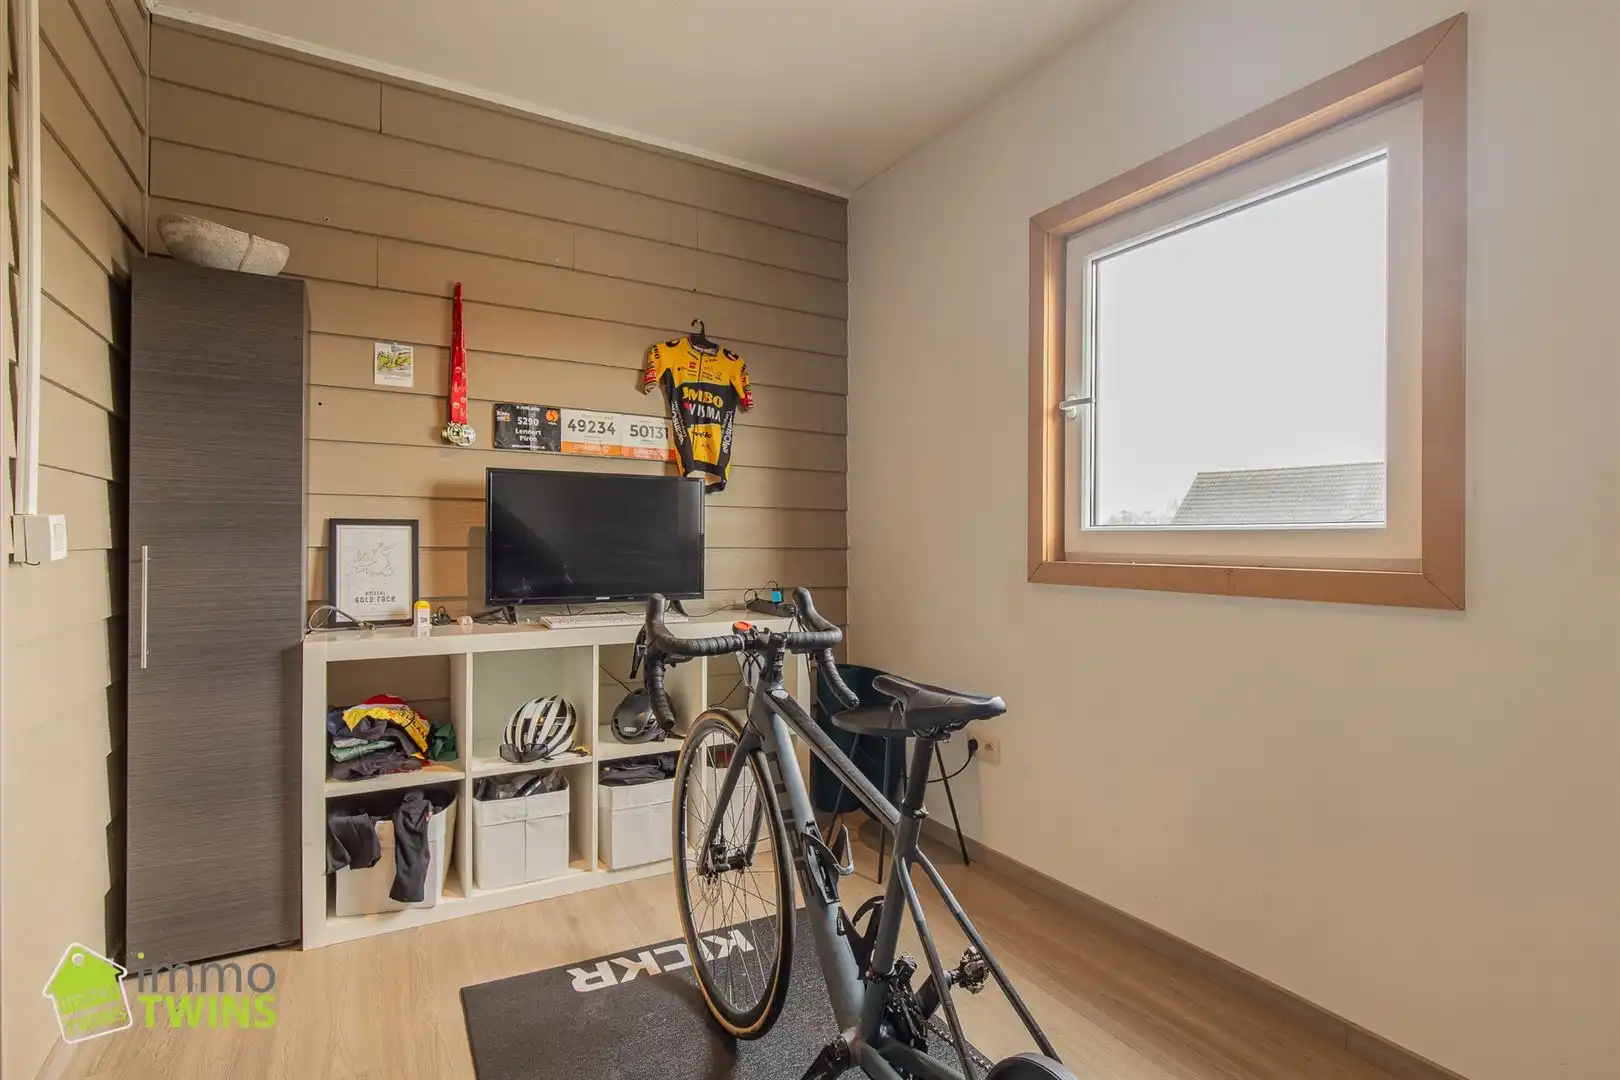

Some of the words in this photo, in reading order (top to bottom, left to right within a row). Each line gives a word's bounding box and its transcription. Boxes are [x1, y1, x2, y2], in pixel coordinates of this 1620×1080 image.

[517, 416, 540, 427] 5290
[689, 403, 721, 422] VISMA
[567, 418, 617, 436] 49234
